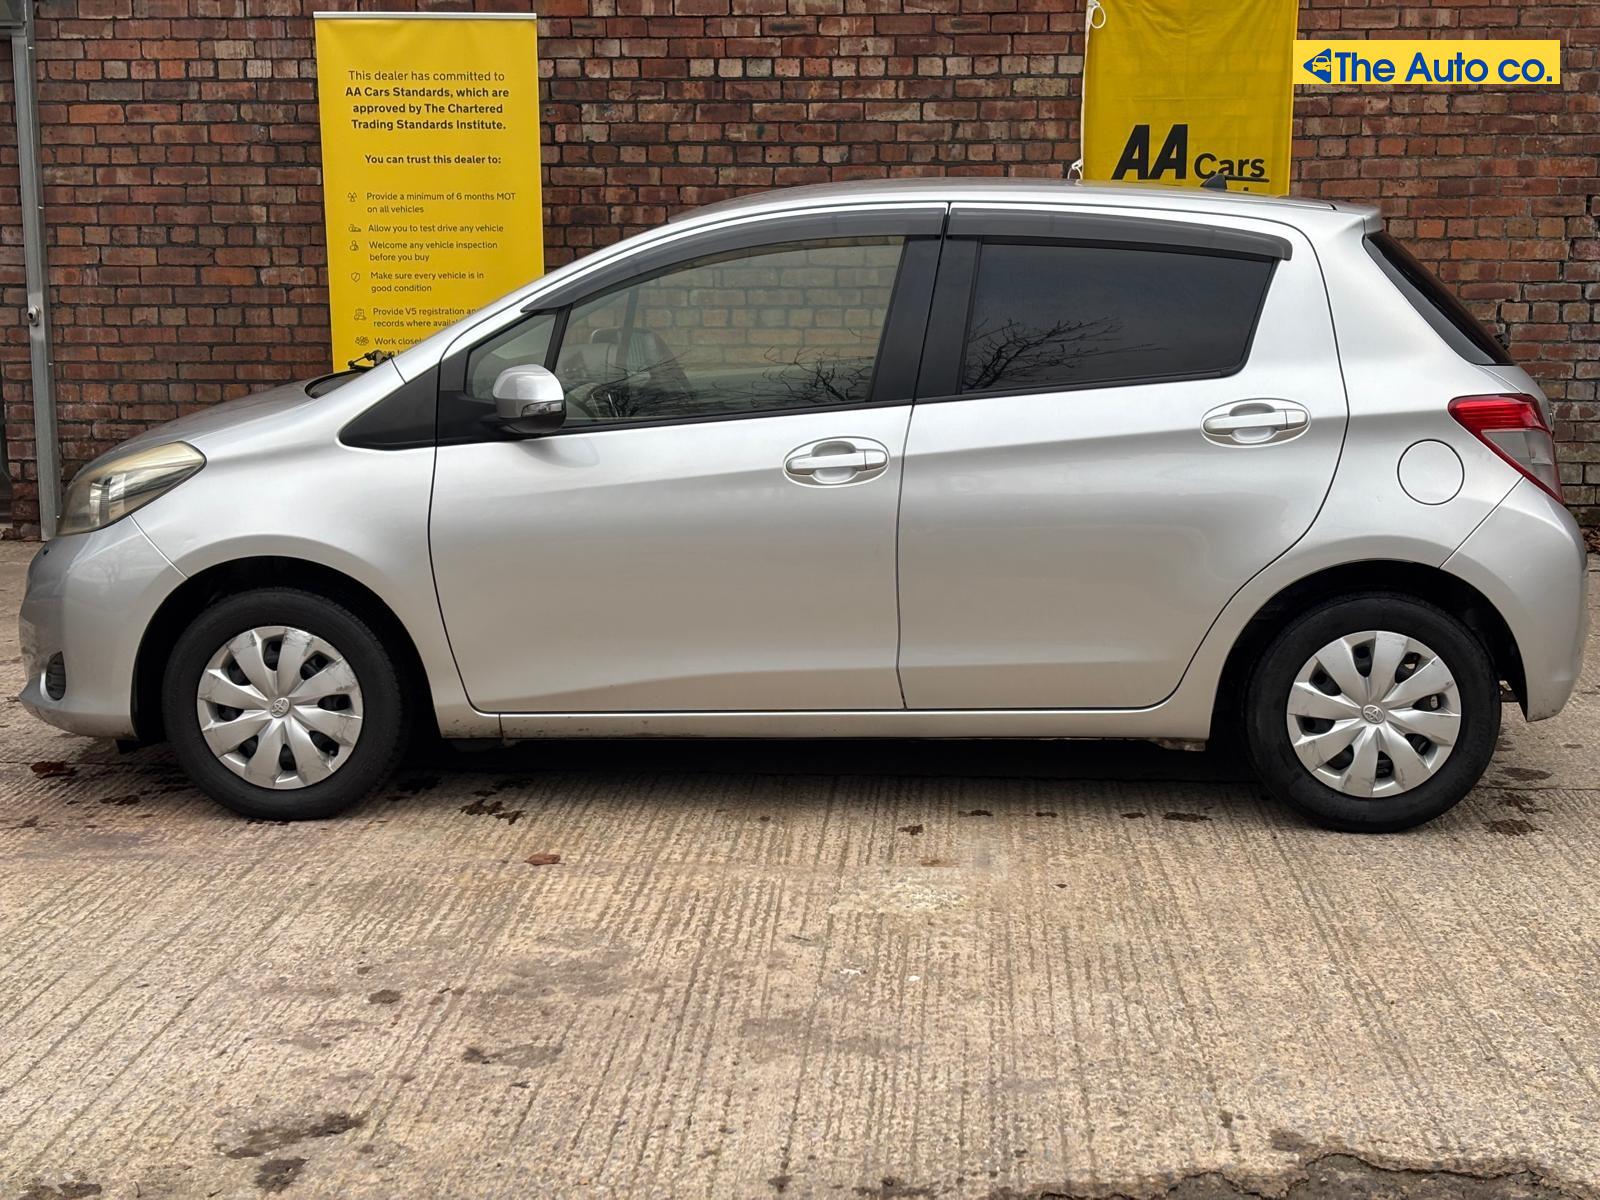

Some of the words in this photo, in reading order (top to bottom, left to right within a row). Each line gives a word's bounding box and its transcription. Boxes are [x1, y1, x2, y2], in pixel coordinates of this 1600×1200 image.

[348, 71, 371, 80] This
[374, 71, 408, 80] dealer
[411, 72, 430, 80] has
[433, 72, 490, 81] committed
[494, 72, 505, 81] to
[346, 87, 361, 96] AA
[364, 88, 389, 97] Cars
[393, 88, 453, 98] Standards,
[456, 88, 489, 97] which
[353, 104, 405, 114] approved
[409, 104, 421, 114] by
[424, 104, 445, 113] The
[448, 104, 503, 113] Chartered
[352, 120, 393, 130] Trading
[397, 120, 453, 129] Standards
[457, 120, 506, 129] Institute.
[1110, 124, 1188, 180] AA
[1194, 153, 1265, 179] Cars
[365, 155, 384, 163] You
[407, 155, 431, 163] trust
[434, 155, 451, 163] this
[454, 156, 485, 164] dealer
[488, 156, 501, 164] to:
[456, 241, 497, 250] inspection
[415, 254, 429, 262] buy
[372, 285, 392, 293] good
[419, 308, 464, 316] registration
